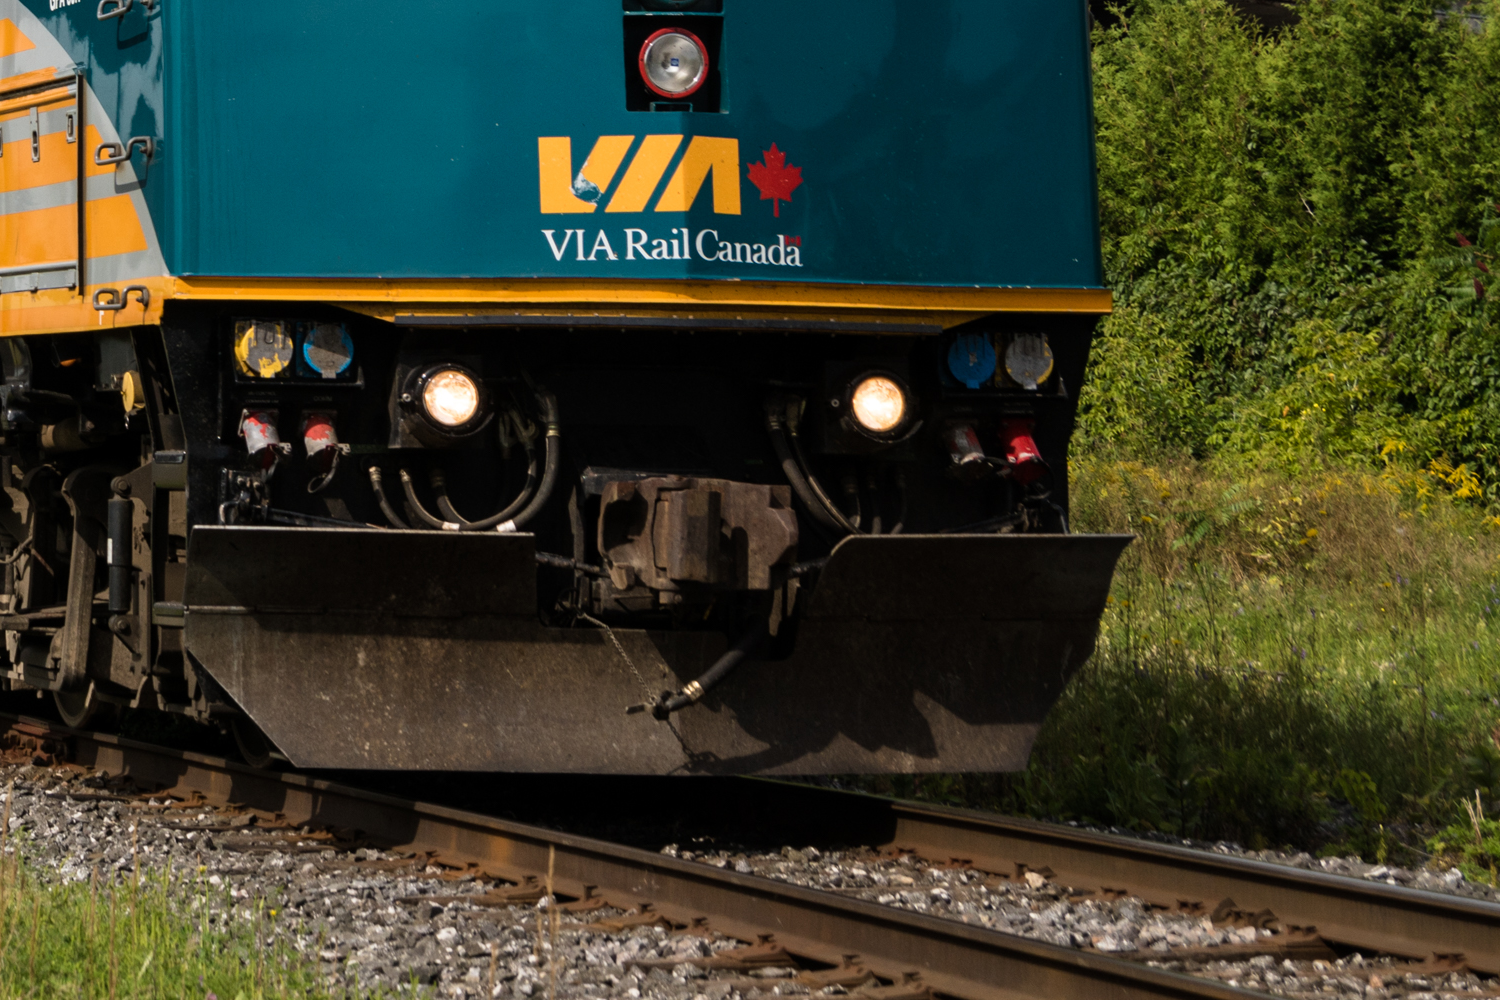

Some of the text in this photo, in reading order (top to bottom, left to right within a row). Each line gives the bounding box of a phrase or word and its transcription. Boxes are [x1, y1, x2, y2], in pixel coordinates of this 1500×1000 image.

[538, 134, 741, 215] VIA
[541, 228, 804, 267] VIA Rail Canada
